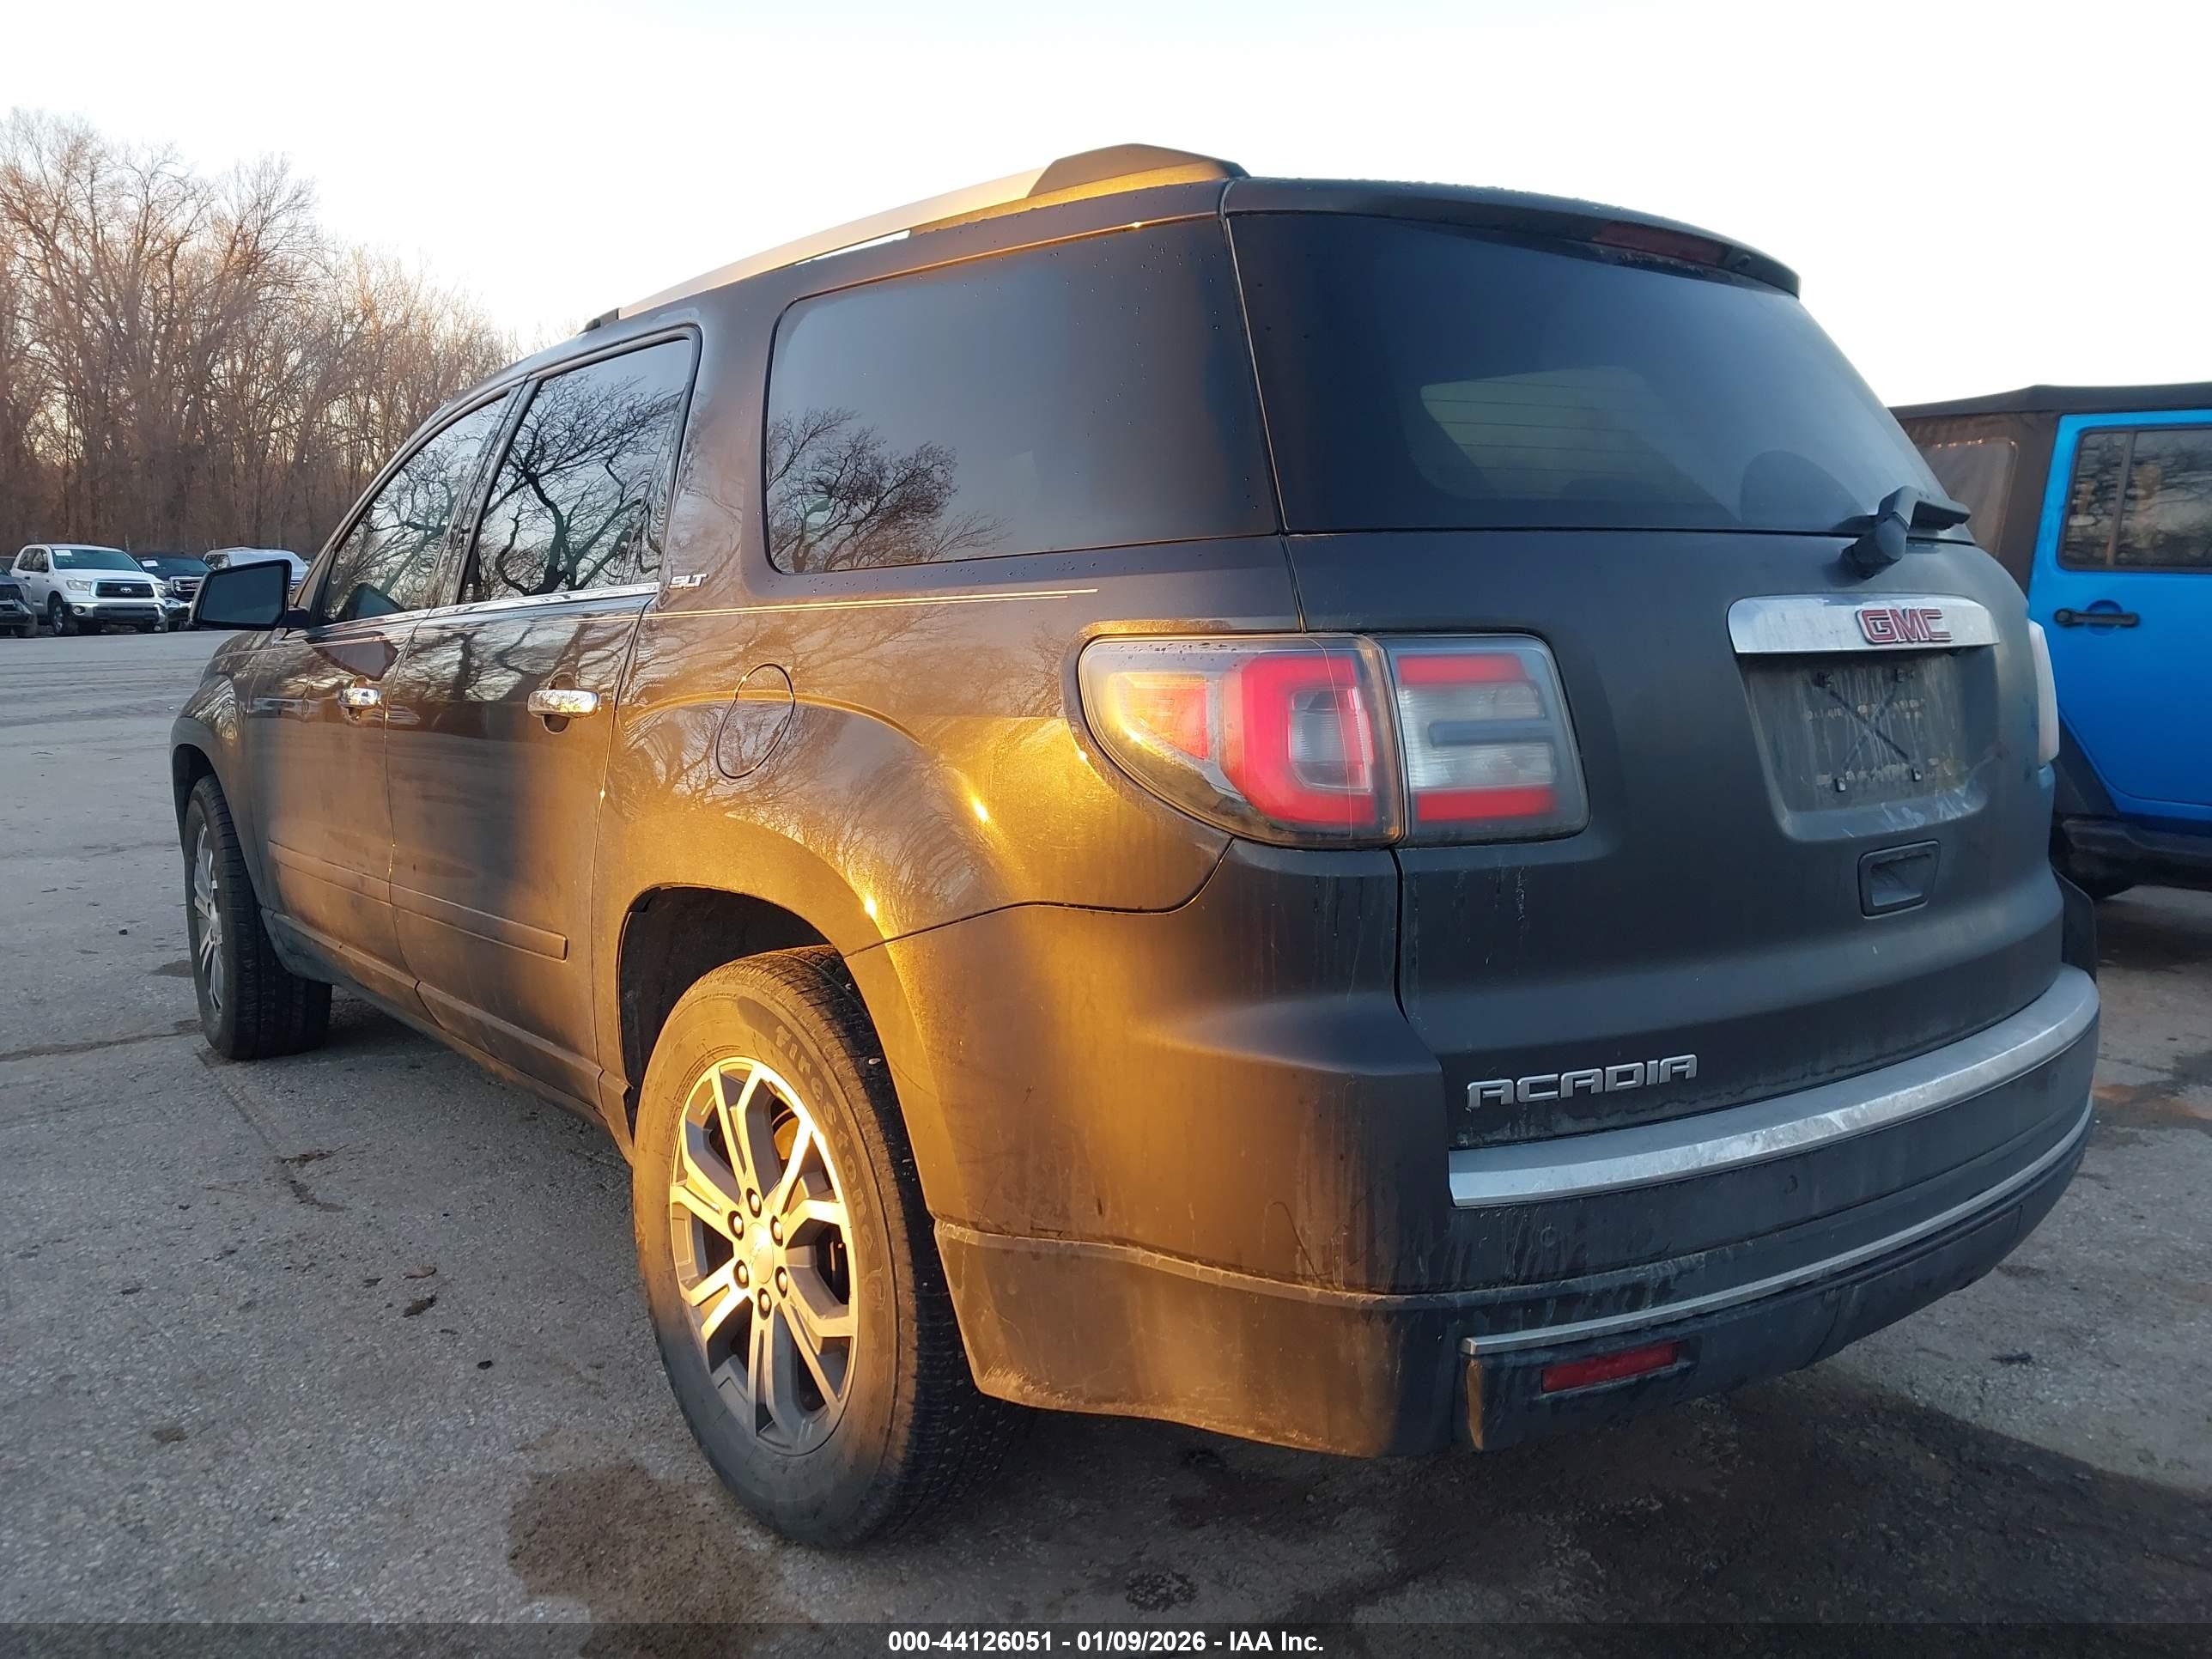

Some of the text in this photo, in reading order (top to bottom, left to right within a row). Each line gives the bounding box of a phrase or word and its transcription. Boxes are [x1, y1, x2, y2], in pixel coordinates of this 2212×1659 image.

[669, 573, 708, 590] SLT
[1856, 608, 1954, 644] GMC
[1466, 1053, 1698, 1109] ACADIA
[775, 1024, 874, 1251] Firestone
